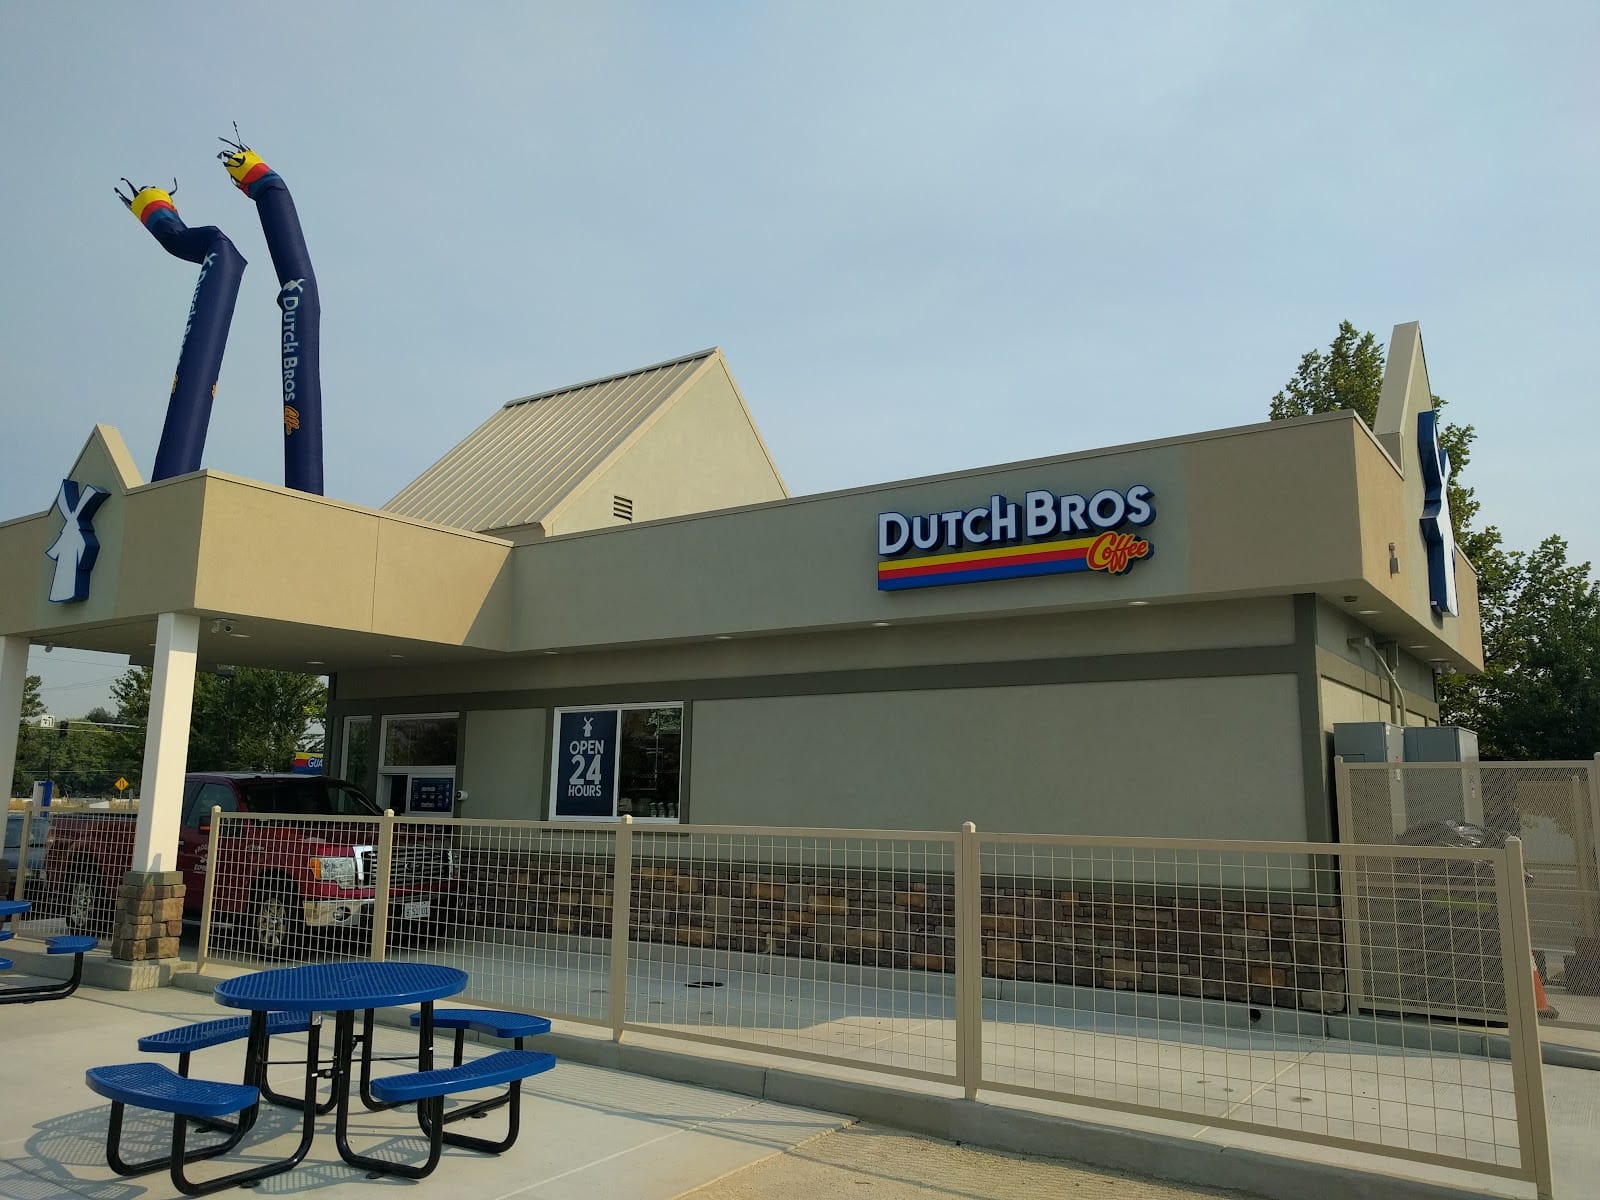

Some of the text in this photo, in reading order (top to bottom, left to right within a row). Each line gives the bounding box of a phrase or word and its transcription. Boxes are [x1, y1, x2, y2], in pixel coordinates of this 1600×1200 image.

[283, 296, 299, 353] DUTCH
[283, 356, 298, 402] BROS
[878, 484, 1156, 556] DUTCH BROS
[1087, 530, 1150, 574] Coffee
[569, 740, 604, 755] OPEN
[569, 754, 602, 785] 24
[568, 785, 602, 797] HOURS
